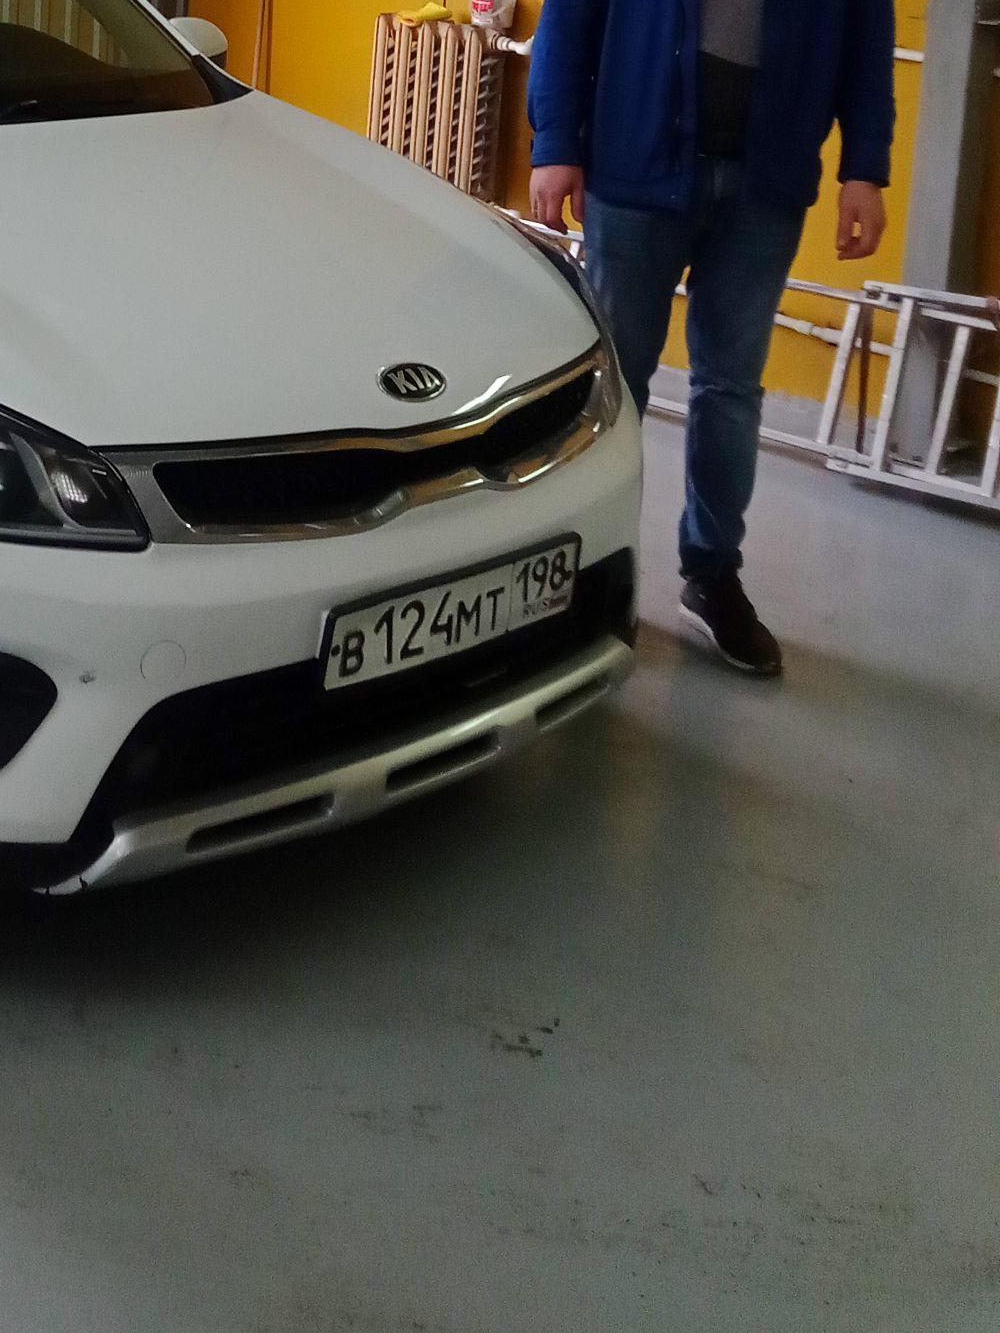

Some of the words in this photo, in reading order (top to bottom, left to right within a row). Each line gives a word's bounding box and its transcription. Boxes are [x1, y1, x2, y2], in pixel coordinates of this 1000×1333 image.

[387, 366, 441, 394] KIA
[337, 586, 505, 679] В124МТ
[515, 549, 567, 603] 198
